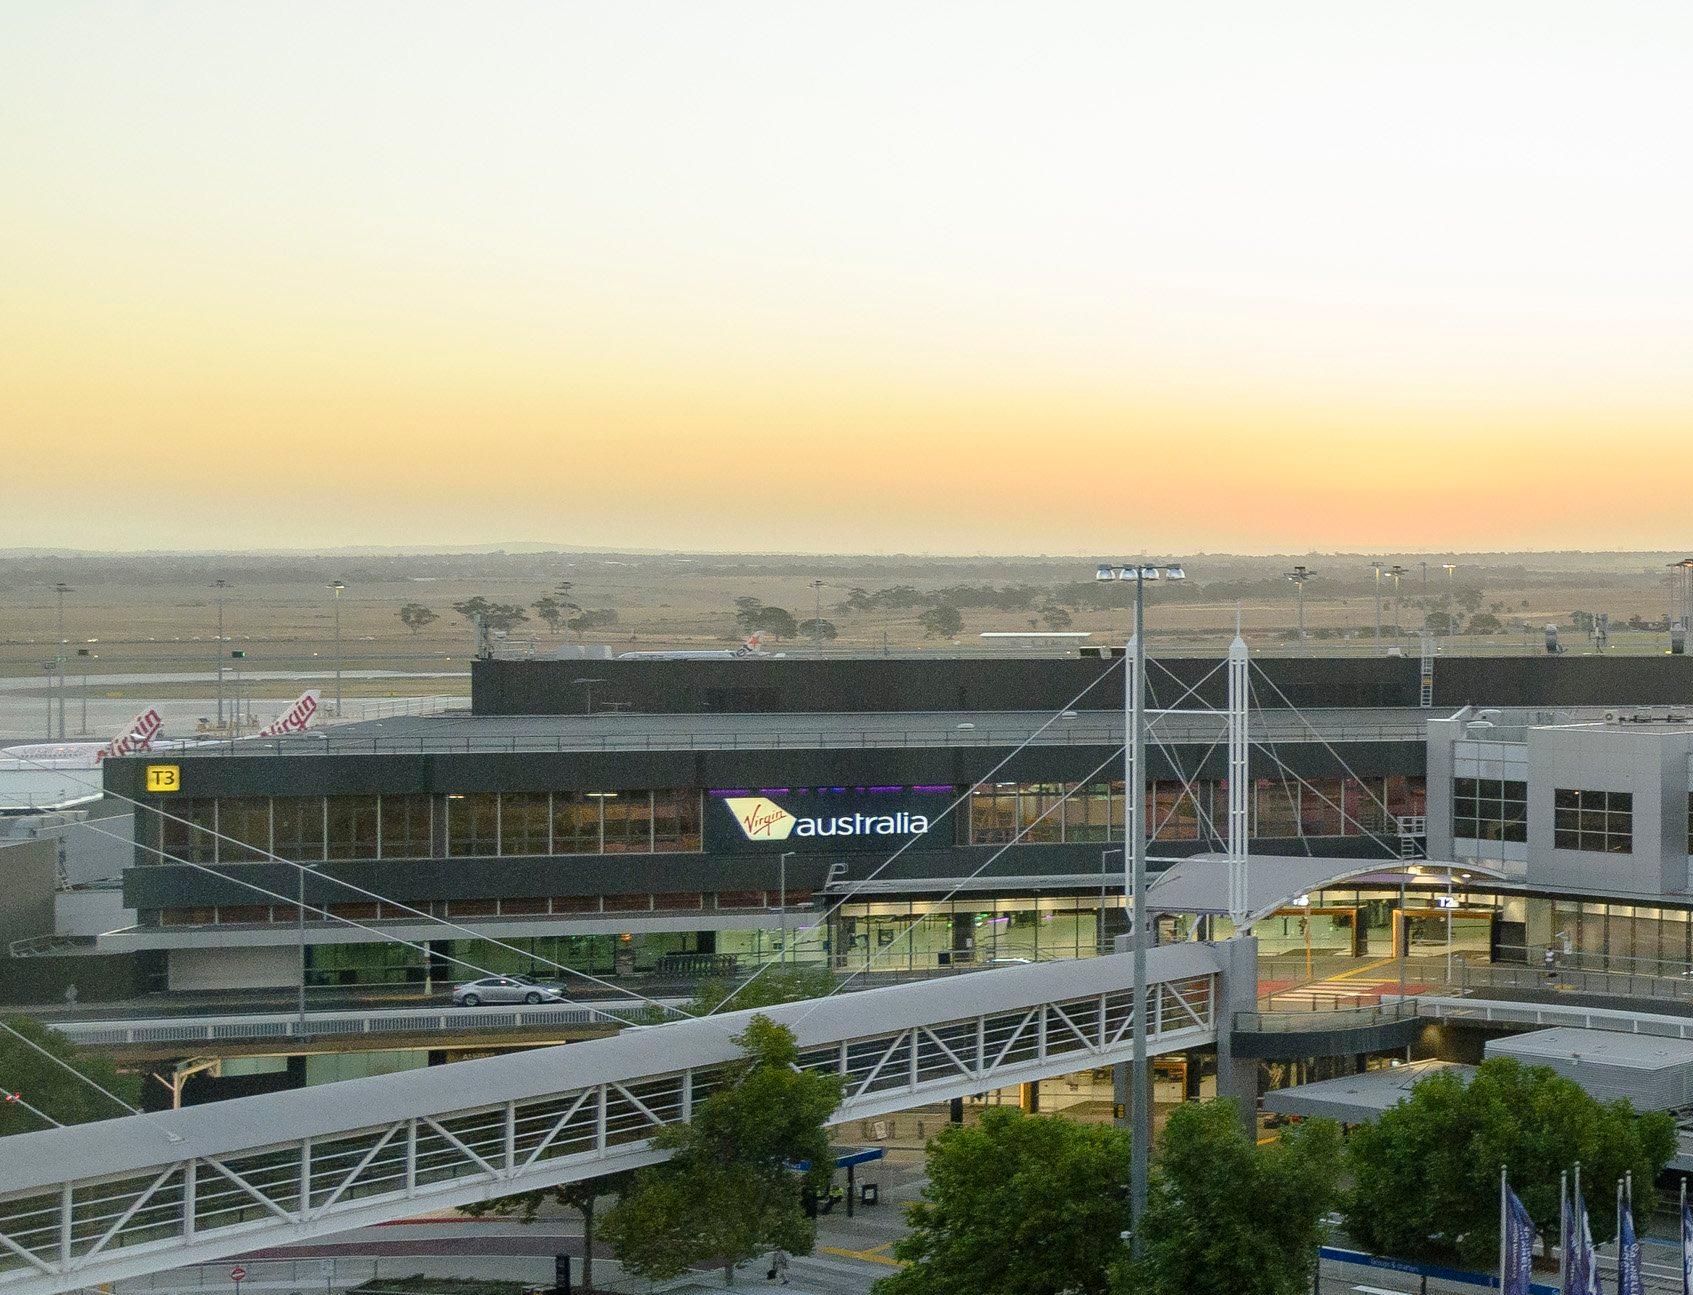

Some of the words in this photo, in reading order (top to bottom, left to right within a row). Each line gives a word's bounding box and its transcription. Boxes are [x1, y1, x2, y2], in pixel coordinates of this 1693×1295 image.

[153, 771, 175, 785] T3
[744, 804, 788, 836] Virgin
[796, 812, 929, 836] australia
